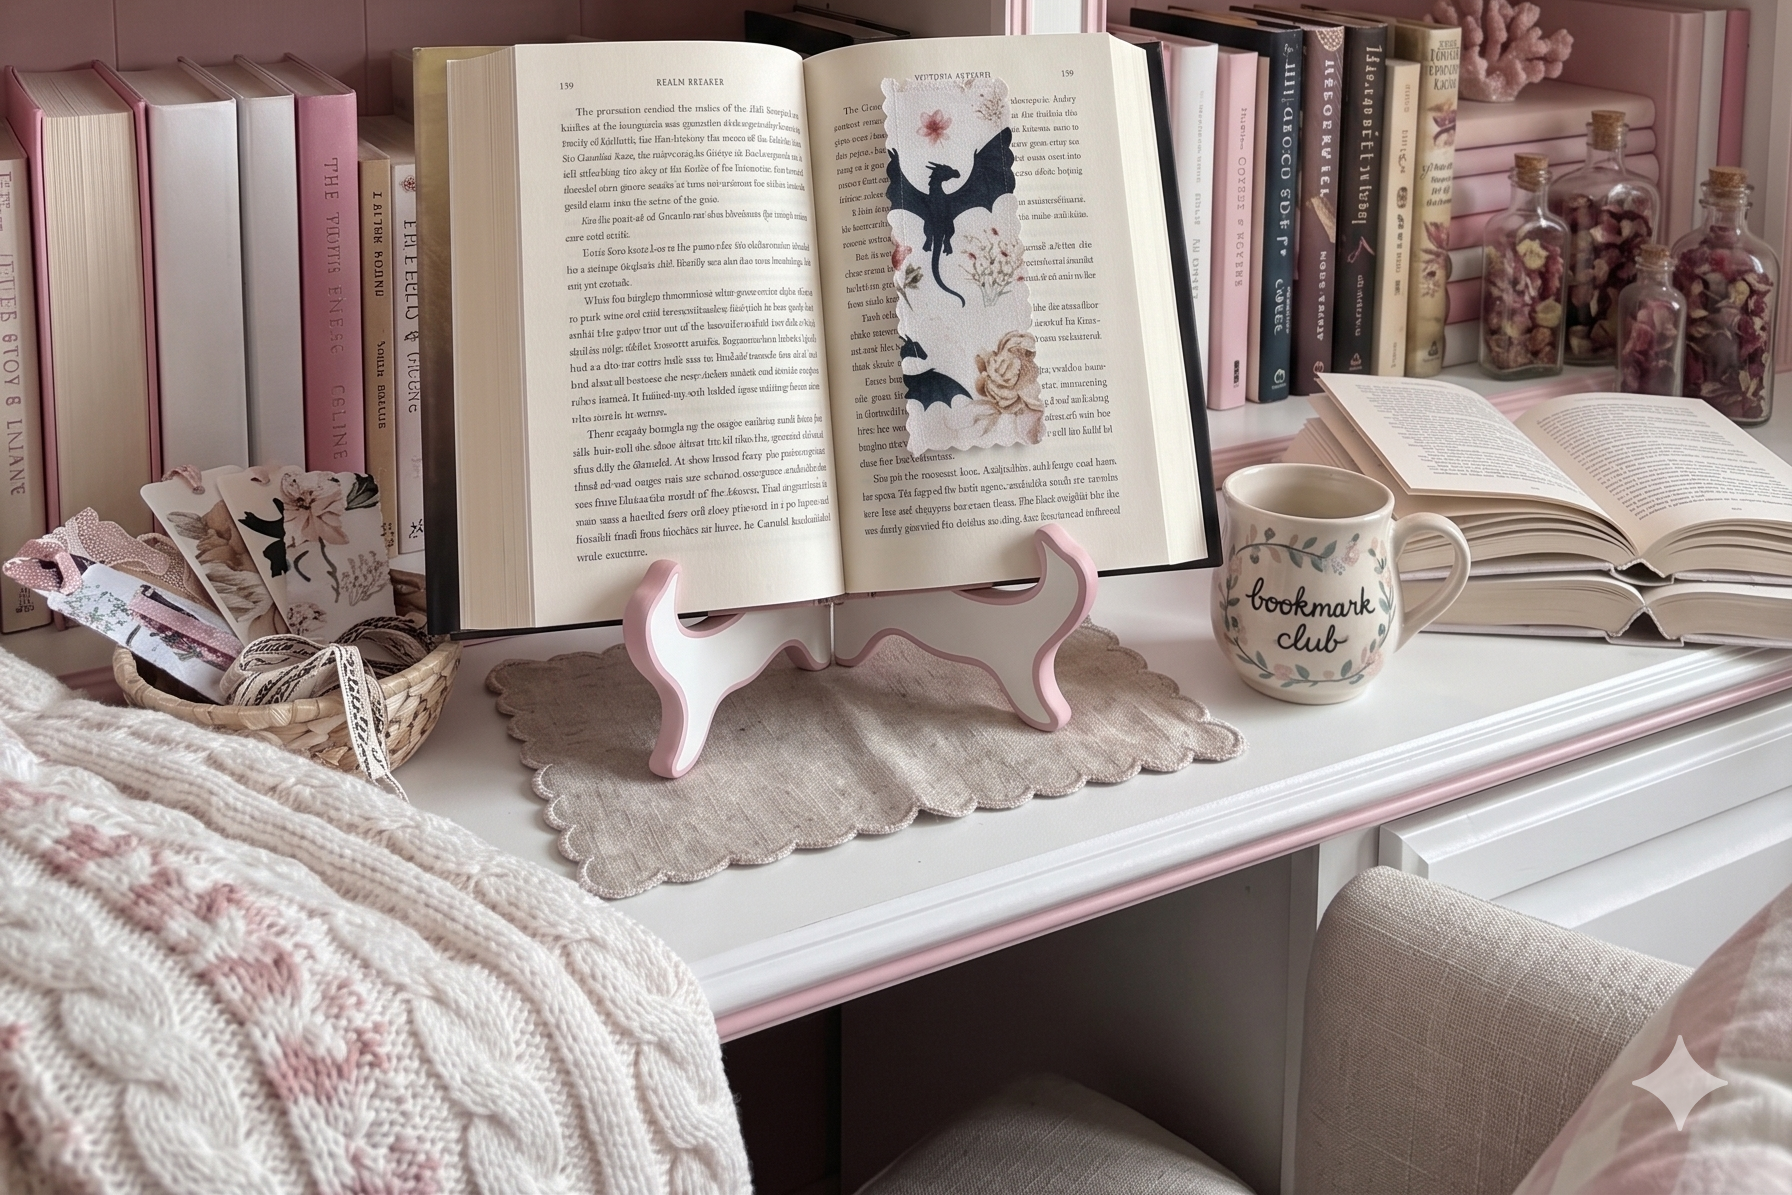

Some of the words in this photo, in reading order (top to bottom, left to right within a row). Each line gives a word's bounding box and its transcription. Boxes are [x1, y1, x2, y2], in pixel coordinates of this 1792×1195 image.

[575, 107, 594, 116] The
[678, 104, 692, 113] the
[722, 103, 733, 112] of
[324, 157, 340, 200] THE
[673, 194, 683, 205] of
[683, 195, 697, 204] the
[690, 321, 705, 331] the
[700, 420, 715, 430] the
[617, 460, 631, 471] the
[904, 471, 919, 481] the
[1245, 577, 1375, 618] bookmark
[1277, 623, 1348, 653] club
